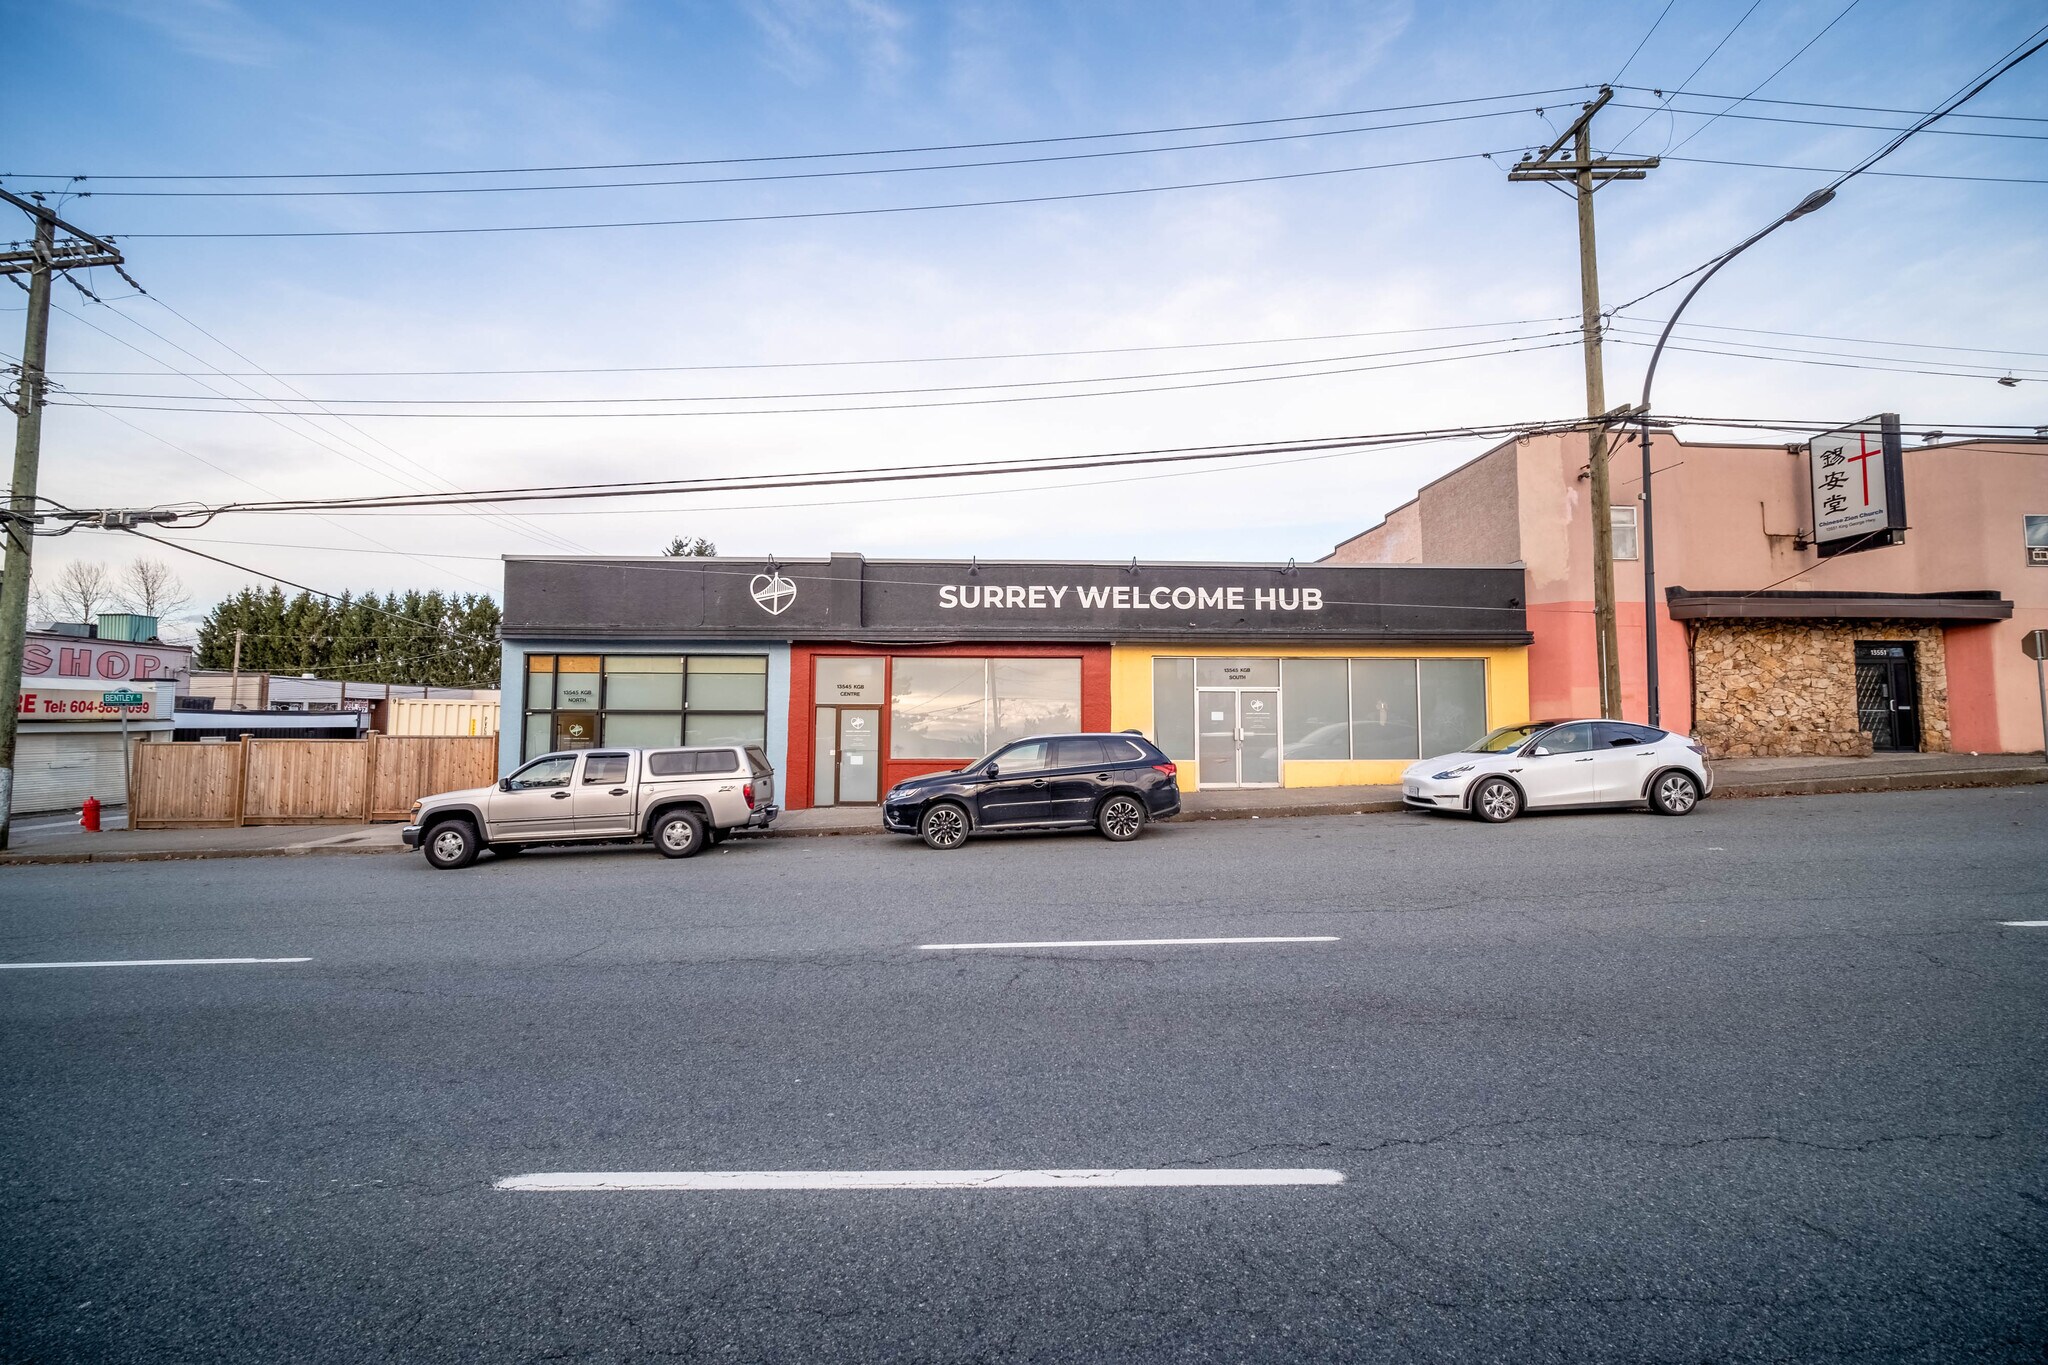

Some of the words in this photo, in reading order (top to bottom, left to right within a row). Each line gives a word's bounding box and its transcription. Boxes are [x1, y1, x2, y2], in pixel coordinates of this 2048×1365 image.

[1818, 446, 1849, 516] 錫安堂
[1819, 519, 1843, 527] Chinese
[1859, 509, 1883, 518] Church
[939, 585, 1069, 609] SURREY
[1076, 586, 1245, 610] WELCOME
[1255, 587, 1324, 611] HUB
[22, 644, 161, 679] SHOP
[44, 700, 67, 713] Tel:
[70, 700, 150, 714] 604-585099
[104, 694, 135, 702] BENTLEY
